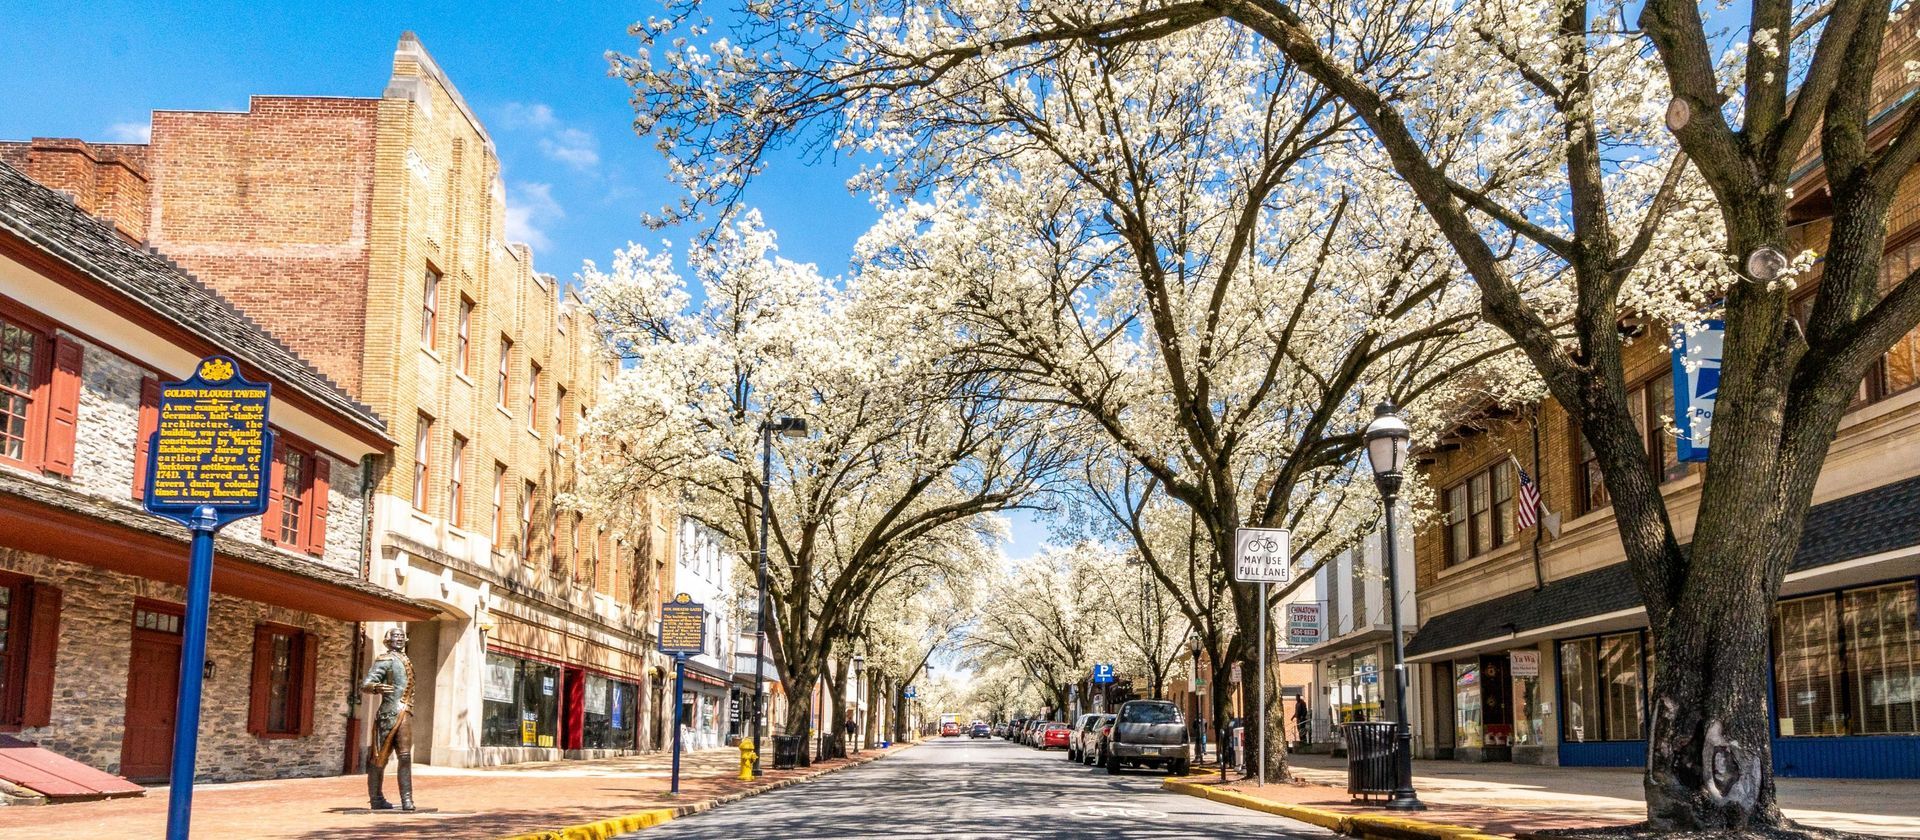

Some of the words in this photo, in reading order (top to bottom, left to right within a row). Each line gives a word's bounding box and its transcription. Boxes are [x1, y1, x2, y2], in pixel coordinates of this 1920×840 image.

[164, 389, 198, 398] GOLDEN
[199, 389, 233, 398] PLOUGH
[234, 389, 267, 398] TAVERN
[163, 403, 172, 411] A
[194, 404, 228, 413] example
[242, 404, 264, 413] early
[210, 412, 264, 420] half-timber
[160, 429, 197, 438] building
[218, 429, 262, 439] originally
[217, 438, 229, 447] by
[233, 437, 262, 446] Martin
[159, 445, 212, 455] Eichelberger
[214, 446, 244, 455] during
[158, 454, 201, 462] earliest
[211, 454, 236, 464] days
[158, 462, 198, 471] Yorktown
[187, 471, 194, 479] It
[155, 480, 185, 488] tavern
[189, 480, 220, 490] during
[224, 480, 259, 488] colonial
[155, 488, 178, 496] times
[182, 488, 188, 496] &
[190, 488, 210, 498] long
[213, 488, 258, 497] thereafter.
[1244, 555, 1262, 564] MAY
[1265, 556, 1282, 565] USE
[1239, 566, 1260, 576] FULL
[1263, 567, 1286, 577] LANE
[1291, 606, 1319, 614] CHINATOWN
[1293, 614, 1316, 622] EXPRESS
[1514, 655, 1523, 663] Ya
[1523, 655, 1536, 663] Wa
[1100, 665, 1109, 675] P
